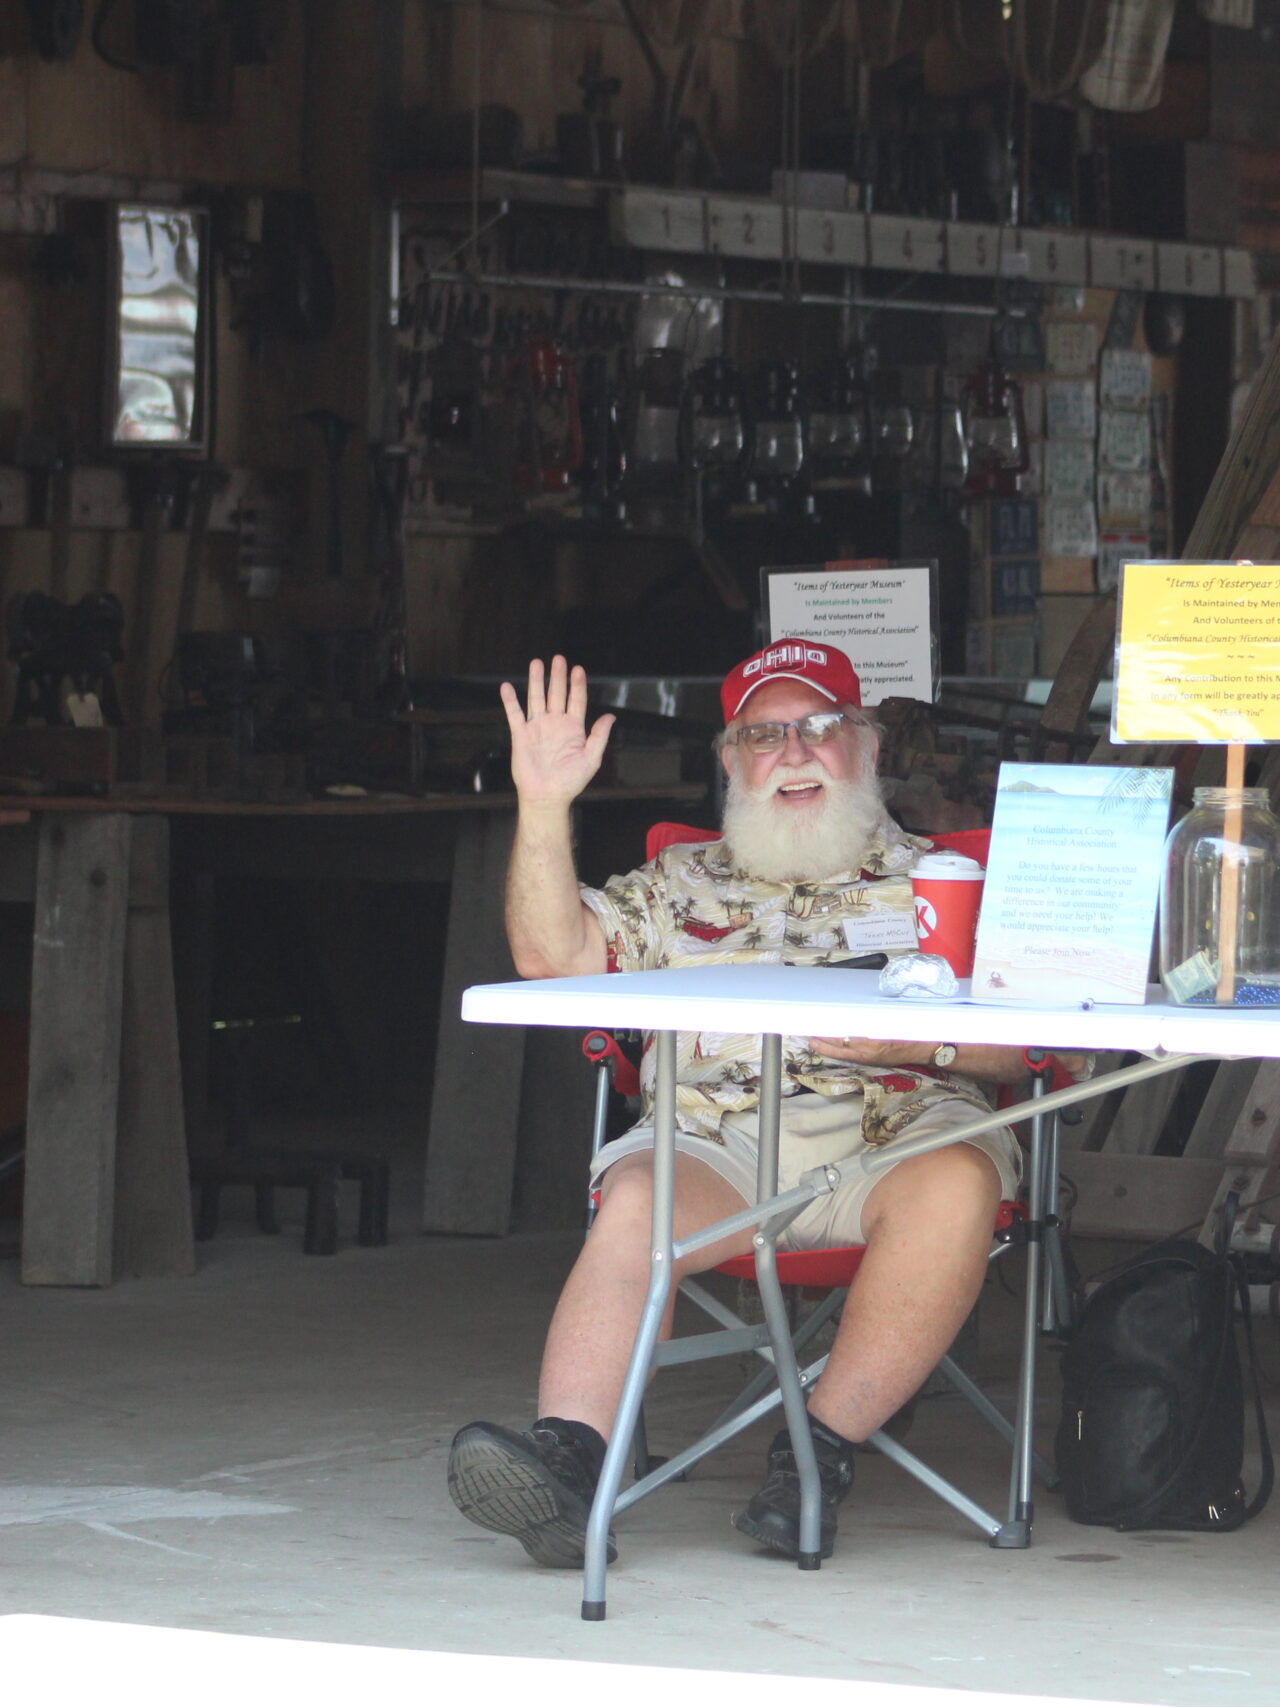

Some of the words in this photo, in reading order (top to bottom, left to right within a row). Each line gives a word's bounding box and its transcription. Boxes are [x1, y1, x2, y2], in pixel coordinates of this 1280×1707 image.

[660, 205, 671, 239] 1
[741, 212, 755, 245] 2
[819, 581, 830, 593] of
[830, 580, 869, 592] Yesteryear
[1166, 577, 1199, 589] "Items
[1202, 577, 1216, 591] of
[1218, 578, 1272, 591] Yesteryear
[812, 598, 850, 606] Maintained
[861, 597, 893, 605] Members
[1183, 599, 1191, 608] Is
[1192, 599, 1245, 608] Maintained
[1247, 599, 1258, 609] by
[813, 613, 827, 621] And
[828, 612, 864, 621] Volunteers
[865, 612, 873, 620] of
[873, 612, 886, 620] the
[1192, 616, 1211, 625] And
[1213, 616, 1264, 625] Volunteers
[1265, 616, 1276, 625] of
[823, 628, 847, 638] County
[848, 627, 880, 636] Historical
[1204, 634, 1237, 645] County
[742, 645, 828, 678] OHIO
[1184, 674, 1242, 683] Contribution
[1244, 675, 1254, 683] to
[1256, 674, 1273, 683] this
[1204, 691, 1221, 699] will
[1223, 691, 1236, 700] be
[1236, 691, 1269, 701] greatly
[1084, 826, 1115, 838] County
[1018, 860, 1032, 870] Do
[1032, 863, 1049, 872] you
[1050, 862, 1071, 872] have
[1079, 862, 1094, 872] few
[1096, 863, 1120, 873] hours
[1006, 874, 1023, 884] you
[1023, 873, 1048, 883] could
[1049, 873, 1077, 884] donate
[1102, 876, 1112, 885] of
[1112, 878, 1133, 887] your
[1025, 886, 1034, 894] to
[1055, 886, 1069, 896] We
[1070, 888, 1084, 897] are
[1118, 890, 1125, 898] a
[1000, 908, 1017, 918] and
[1032, 910, 1053, 919] need
[1099, 912, 1115, 922] We
